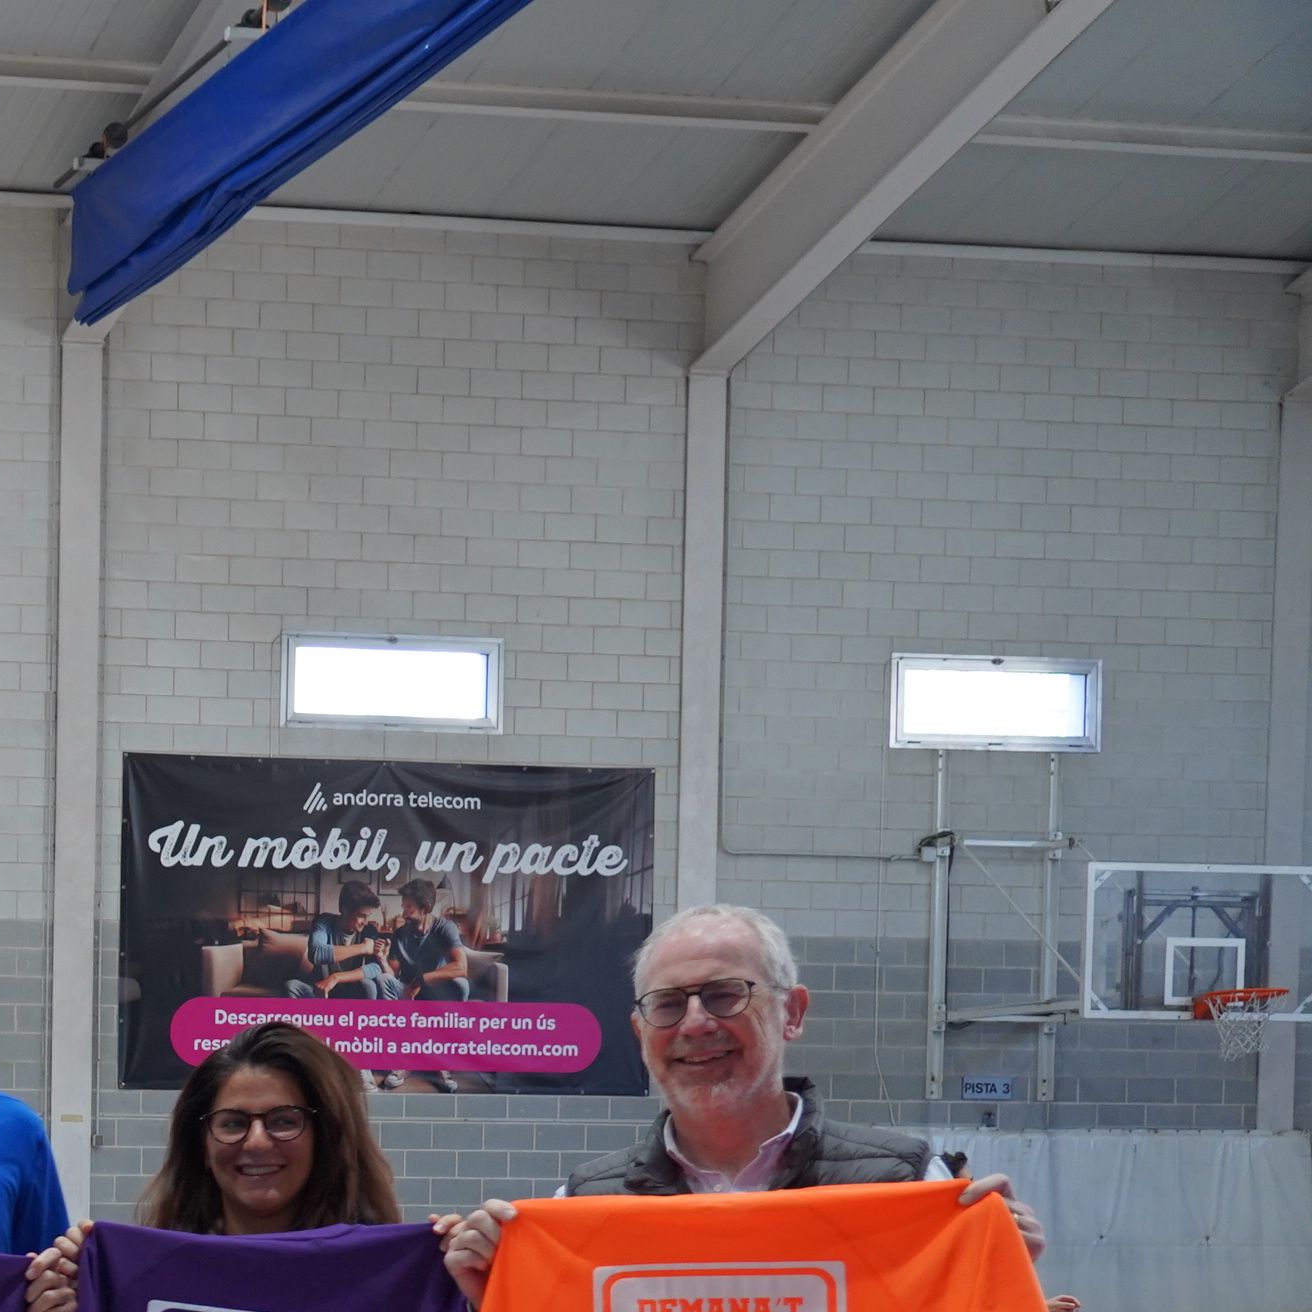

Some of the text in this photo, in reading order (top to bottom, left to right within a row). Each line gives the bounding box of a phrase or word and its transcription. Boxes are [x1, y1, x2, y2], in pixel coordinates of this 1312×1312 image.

[333, 789, 481, 811] andorra telecom
[148, 820, 628, 884] Un mòbil, un pacte
[338, 1011, 354, 1026] el
[357, 1013, 407, 1030] pacte
[410, 1012, 476, 1030] familiar
[479, 1018, 508, 1033] per
[511, 1018, 532, 1030] un
[536, 1015, 556, 1031] ús
[335, 1036, 383, 1054] mòbil
[386, 1043, 398, 1054] a
[400, 1038, 578, 1058] andorratelecom.com
[964, 1083, 1010, 1094] PISTA 3
